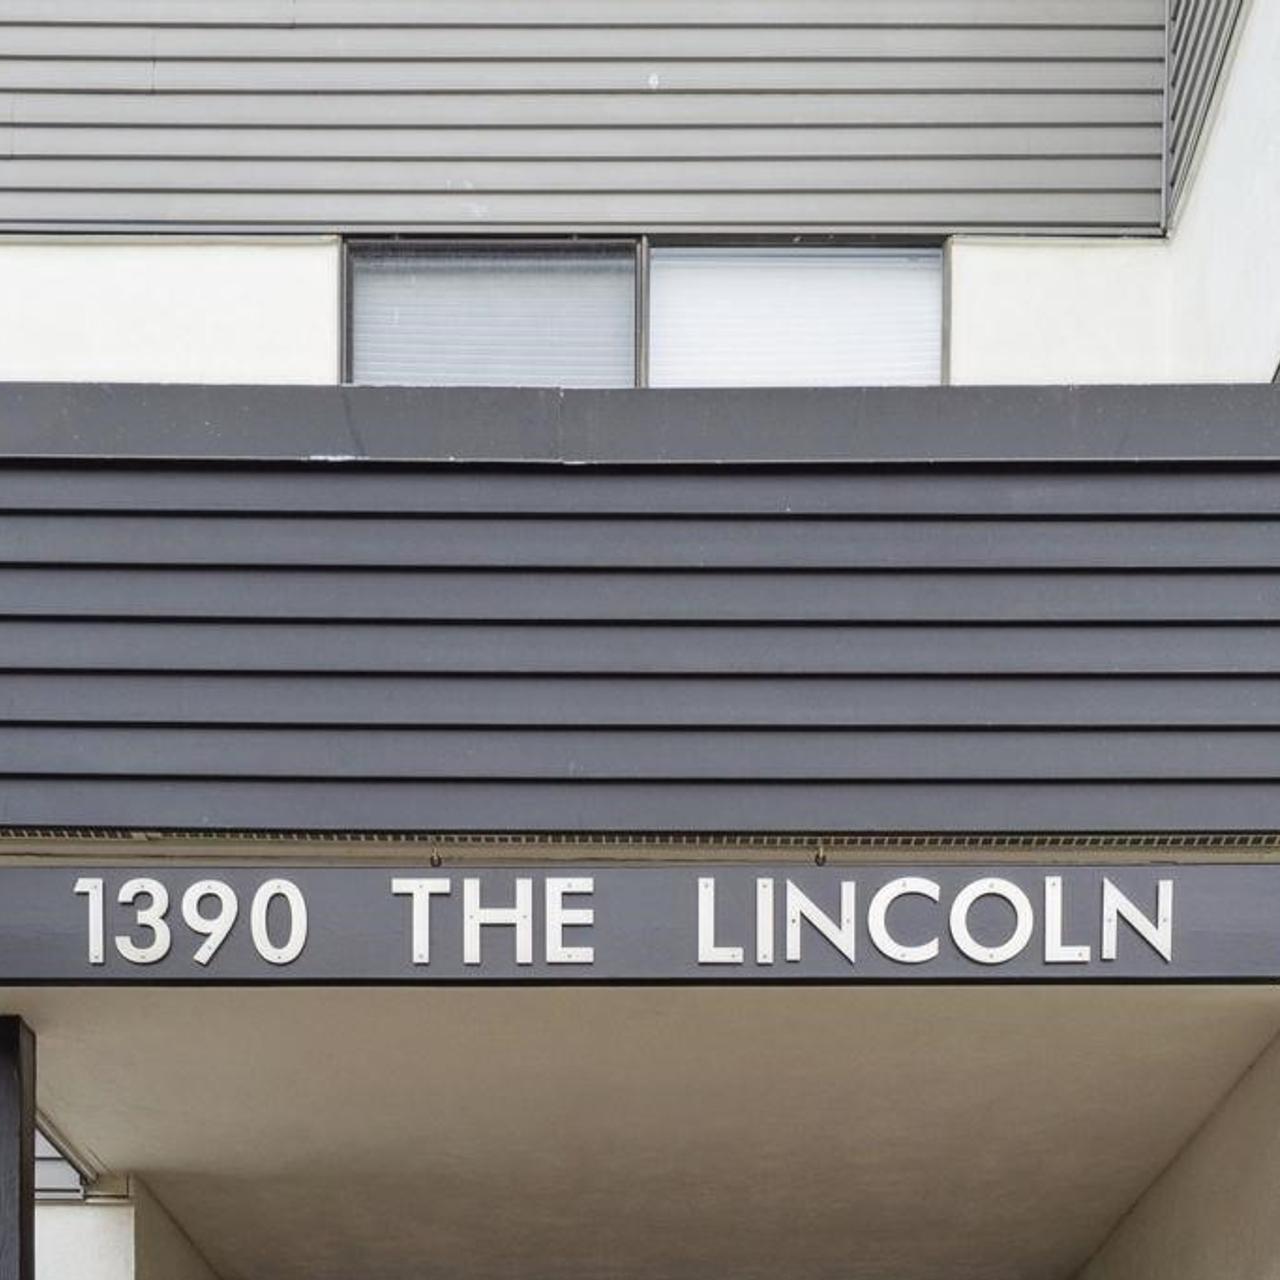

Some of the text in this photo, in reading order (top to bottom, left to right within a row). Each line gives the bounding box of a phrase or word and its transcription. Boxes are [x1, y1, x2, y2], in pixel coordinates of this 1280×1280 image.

[72, 875, 1175, 965] 1390 THE LINCOLN
